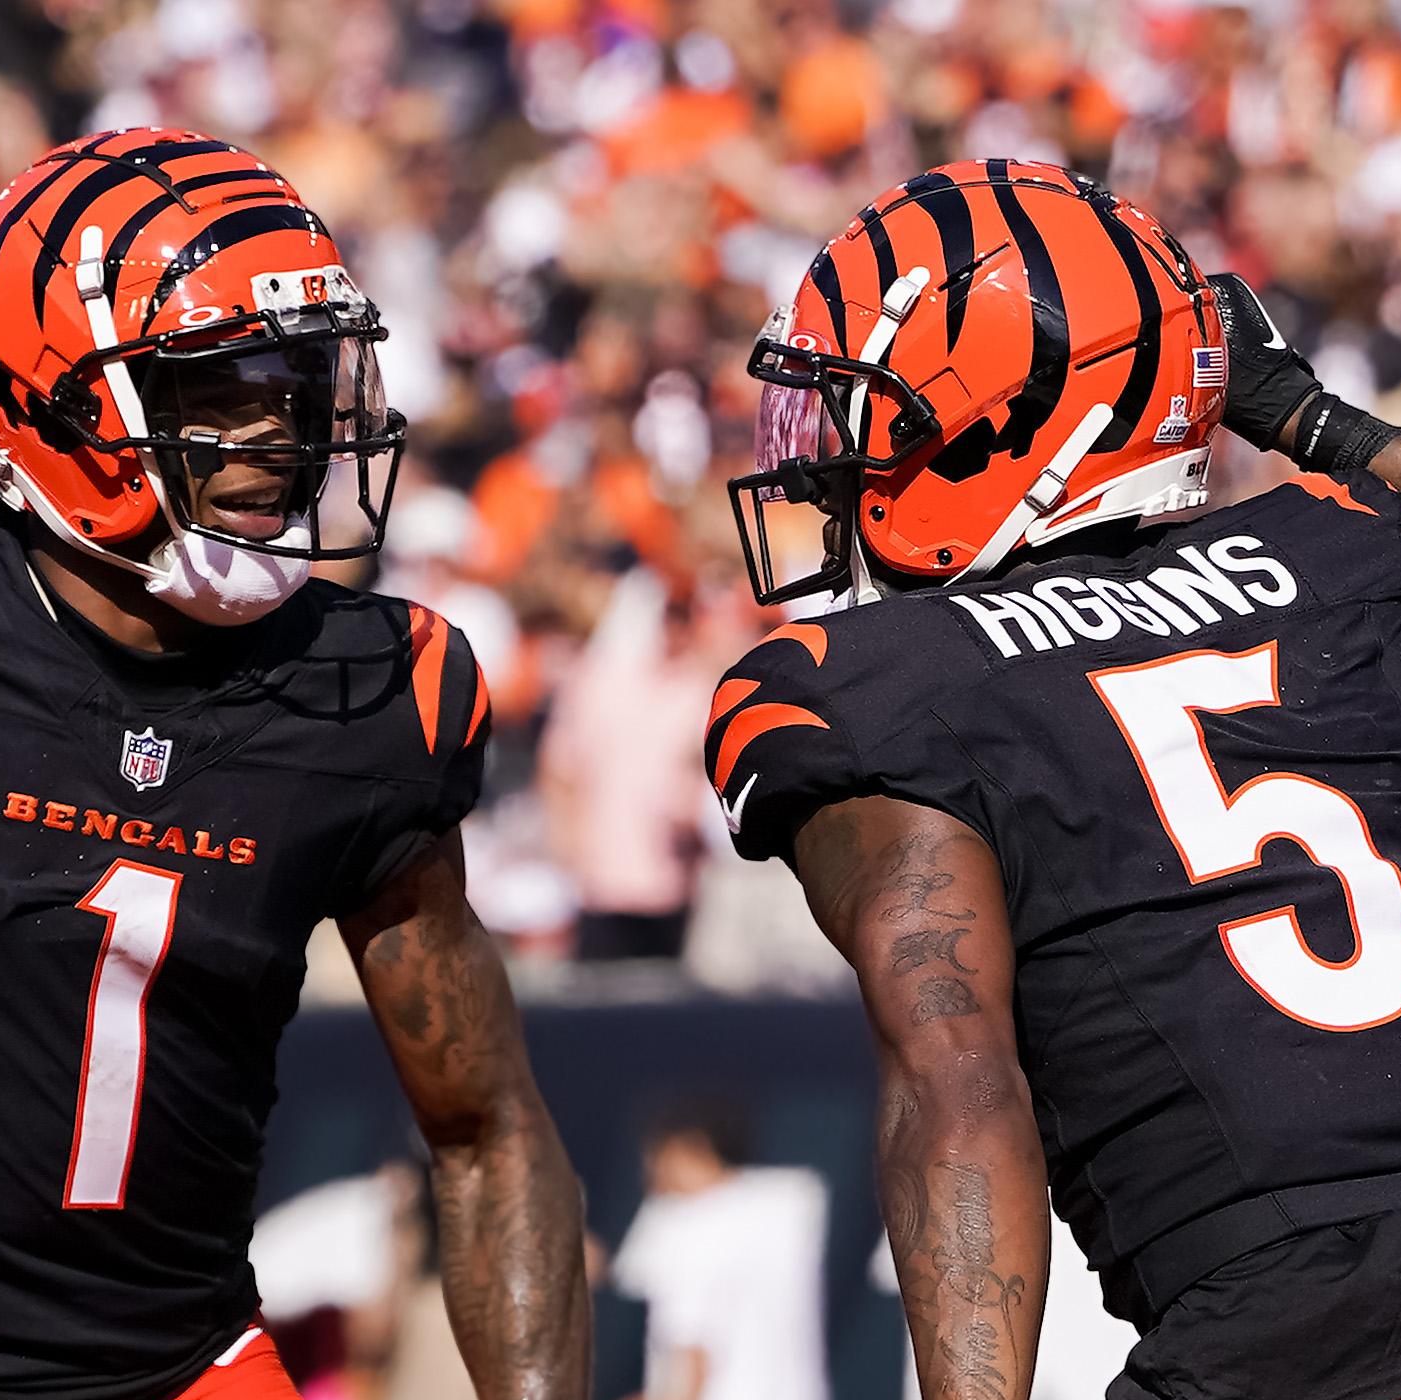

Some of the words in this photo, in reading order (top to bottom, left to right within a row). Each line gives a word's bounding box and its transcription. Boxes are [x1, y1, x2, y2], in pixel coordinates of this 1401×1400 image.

[948, 534, 1299, 659] HIGGINS
[128, 754, 158, 780] NFL
[2, 792, 258, 865] BENGALS
[61, 857, 184, 1210] 1
